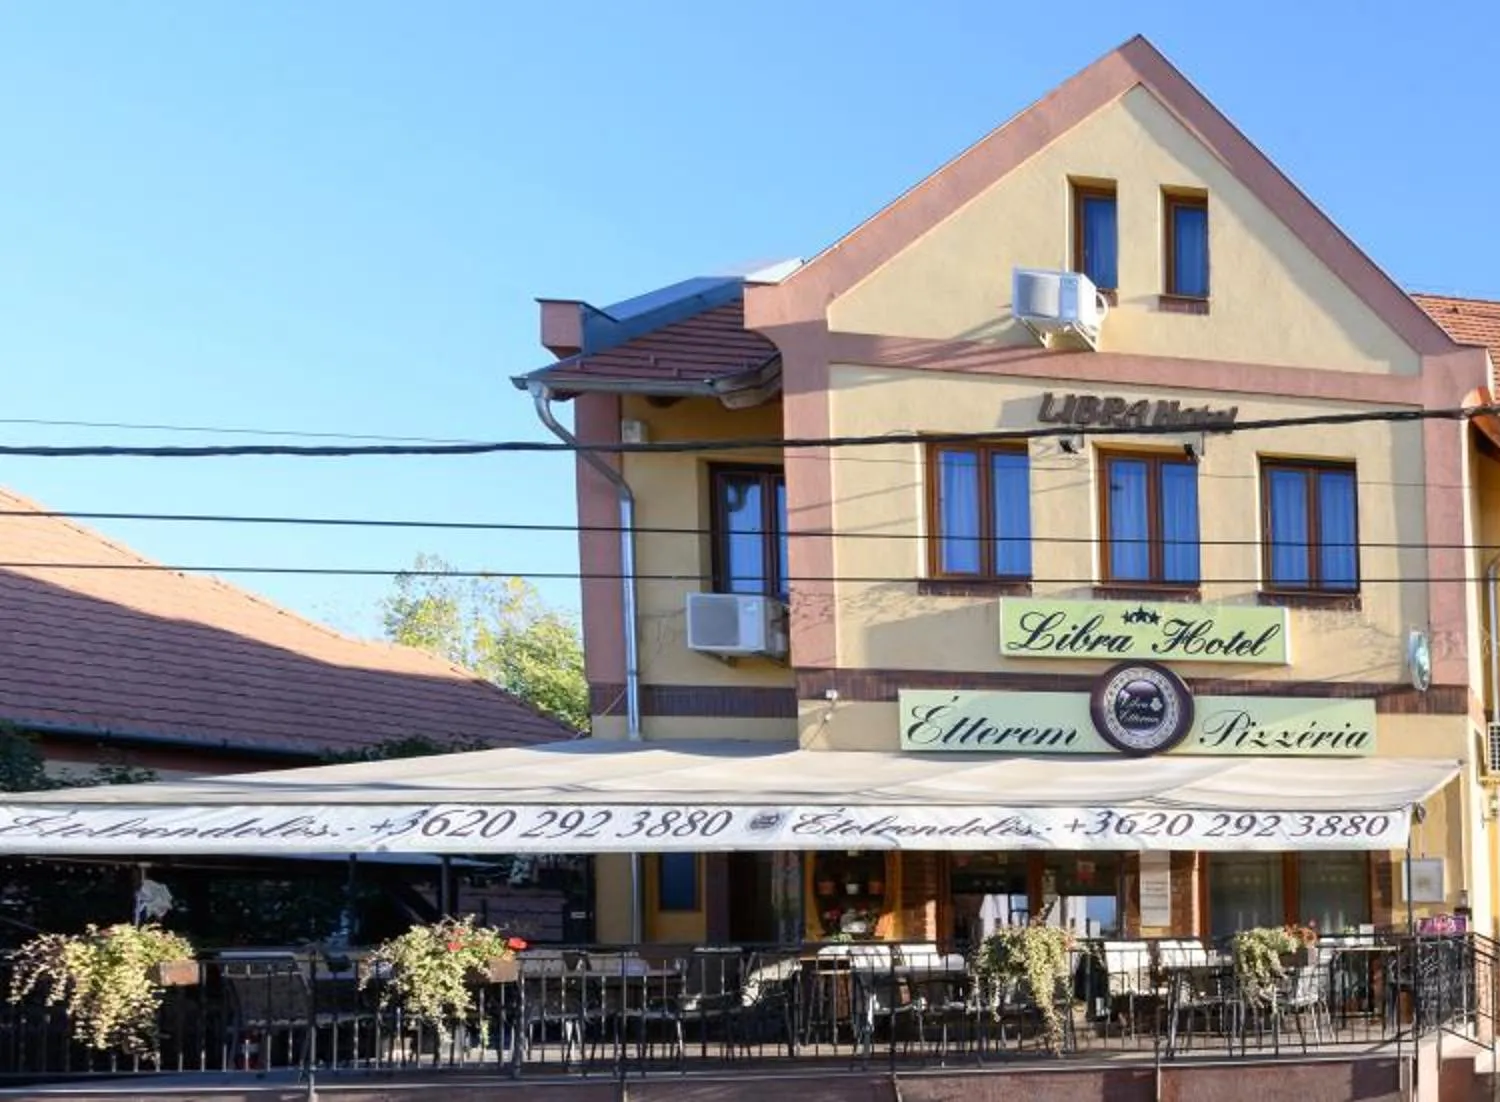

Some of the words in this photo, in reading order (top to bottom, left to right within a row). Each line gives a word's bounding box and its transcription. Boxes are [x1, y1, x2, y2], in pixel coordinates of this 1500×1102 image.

[1037, 391, 1149, 427] LIBRA
[1006, 610, 1135, 654] Libra
[1152, 617, 1282, 656] Hotel
[907, 695, 1080, 745] Étterem
[1200, 709, 1369, 749] Pizzéria
[368, 807, 517, 838] +3620
[519, 809, 613, 839] 292
[615, 809, 733, 838] 3880
[1063, 809, 1195, 838] +3620
[1203, 812, 1282, 838] 292
[1290, 814, 1389, 838] 3880
